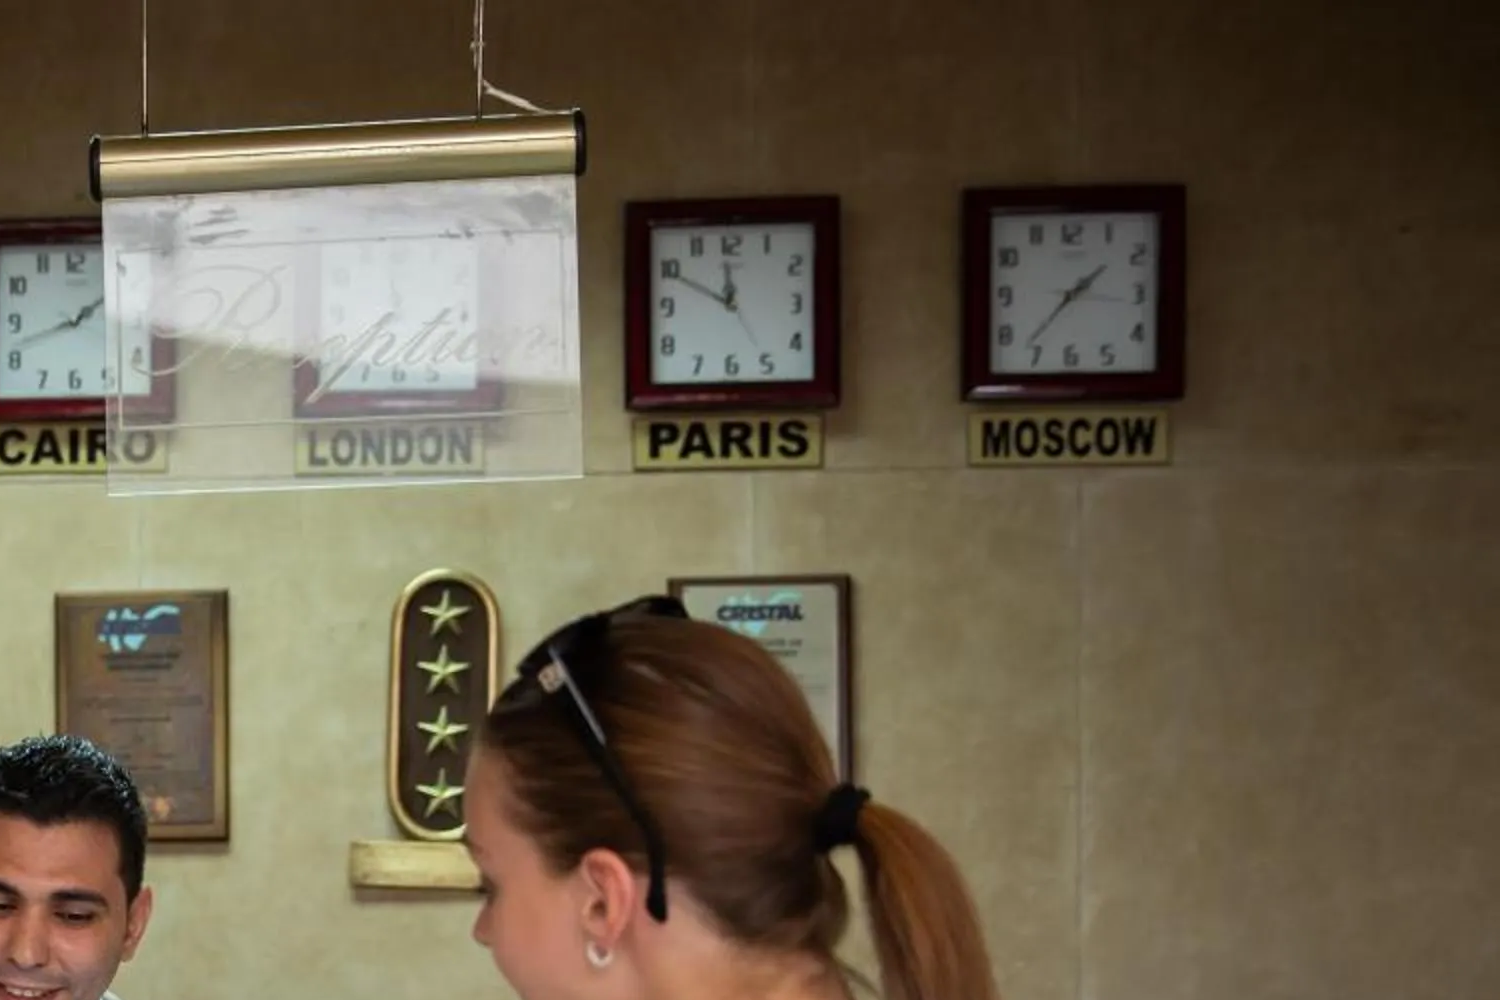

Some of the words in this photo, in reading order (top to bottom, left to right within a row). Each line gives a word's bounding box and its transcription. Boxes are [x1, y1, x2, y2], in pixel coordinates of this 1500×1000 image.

[763, 233, 771, 255] 1
[1061, 224, 1084, 245] 12
[1105, 223, 1112, 244] 1
[690, 236, 704, 257] 11
[721, 235, 742, 256] 12
[1129, 243, 1146, 267] 2
[36, 253, 49, 273] 11
[65, 253, 86, 273] 12
[661, 259, 680, 279] 10
[788, 254, 803, 277] 2
[9, 276, 27, 295] 10
[998, 285, 1012, 308] 9
[1132, 282, 1145, 305] 3
[661, 297, 675, 318] 9
[791, 293, 802, 315] 3
[8, 313, 21, 333] 9
[1129, 322, 1144, 343] 4
[789, 331, 802, 352] 4
[999, 323, 1014, 346] 8
[661, 335, 675, 357] 8
[1030, 345, 1042, 368] 7
[1063, 344, 1079, 367] 6
[1099, 343, 1116, 367] 5
[8, 351, 21, 370] 8
[692, 354, 704, 376] 7
[724, 354, 739, 376] 6
[759, 353, 774, 375] 5
[37, 370, 48, 390] 7
[69, 370, 81, 389] 6
[307, 427, 474, 467] LONDON
[649, 420, 810, 460] PARIS
[981, 417, 1157, 458] MOSCOW
